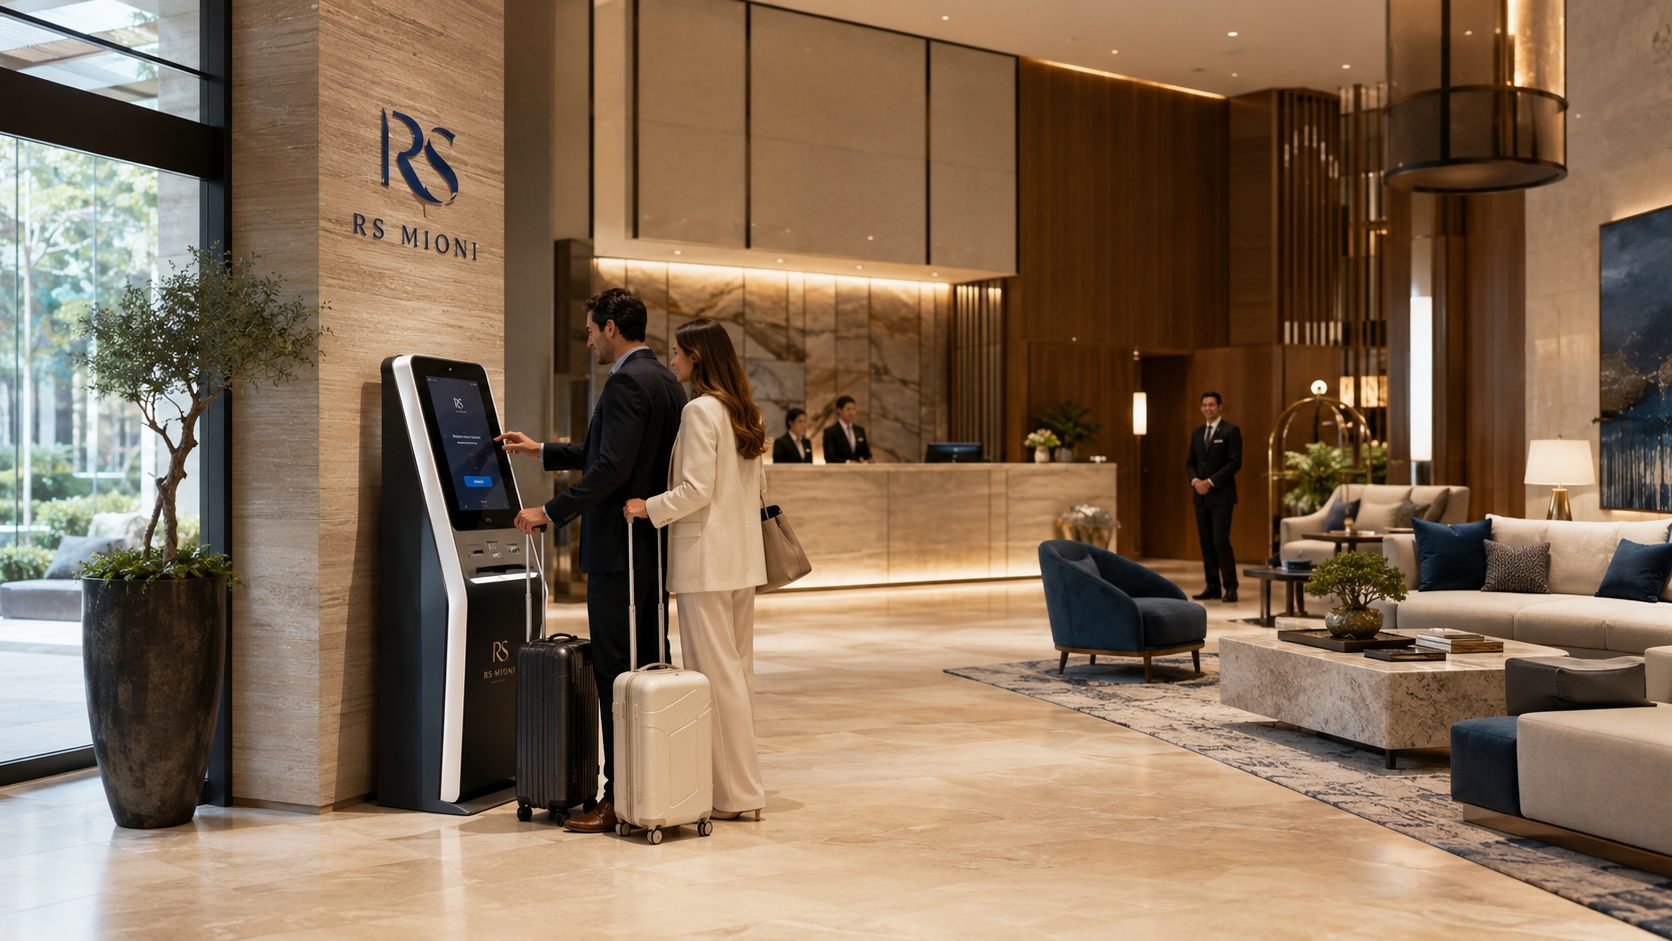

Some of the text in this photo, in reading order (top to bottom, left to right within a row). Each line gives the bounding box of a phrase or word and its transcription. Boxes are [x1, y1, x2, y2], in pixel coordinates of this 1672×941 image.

[380, 107, 459, 206] RS
[353, 212, 477, 261] RS MIONI
[492, 640, 509, 663] RS
[483, 671, 493, 680] RS
